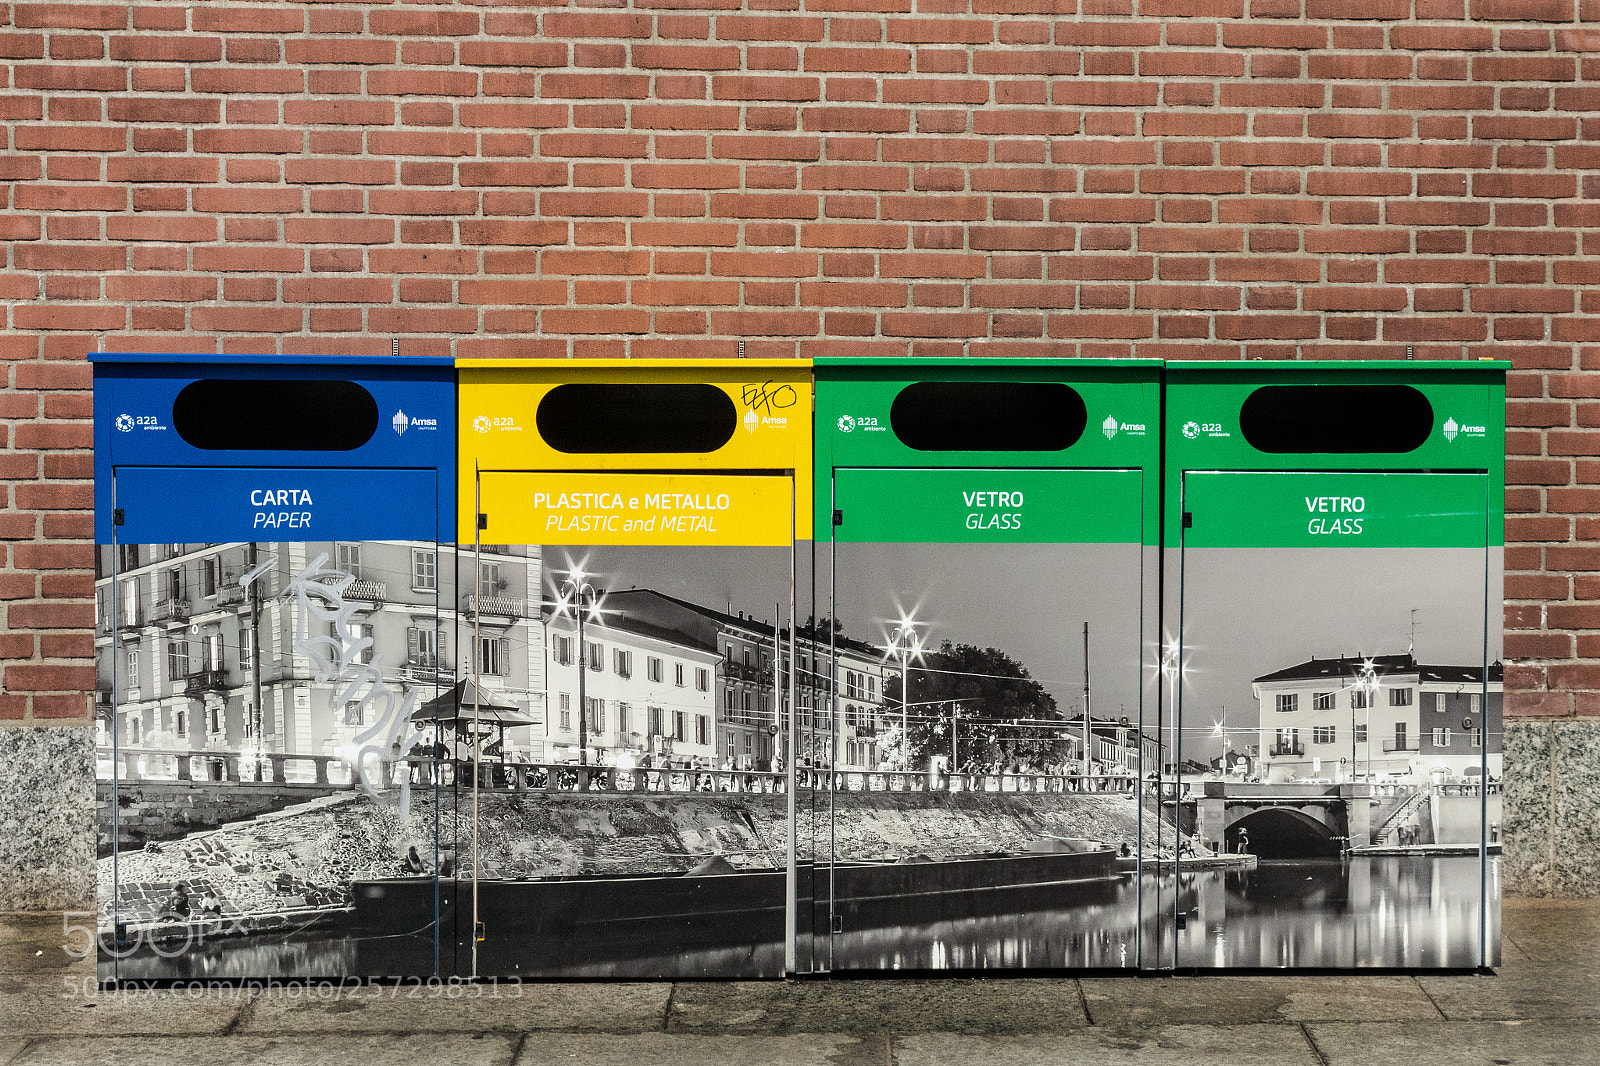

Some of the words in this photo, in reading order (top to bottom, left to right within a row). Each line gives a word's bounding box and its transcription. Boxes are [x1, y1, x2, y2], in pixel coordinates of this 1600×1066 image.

[136, 416, 158, 425] a2a
[411, 417, 437, 426] Amsa
[492, 417, 514, 426] a2a
[761, 416, 787, 425] Amsa
[857, 416, 878, 426] a2a
[1119, 422, 1146, 431] Amsa
[1201, 423, 1222, 432] a2a
[1460, 424, 1486, 433] Amsa
[250, 489, 313, 507] CARTA
[534, 492, 625, 510] PLASTICA
[628, 497, 639, 510] e
[644, 493, 730, 510] METALLO
[962, 491, 1024, 508] VETRO
[1304, 496, 1366, 513] VETRO
[253, 511, 312, 529] PAPER
[545, 515, 620, 532] PLASTIC
[622, 515, 657, 532] and
[660, 515, 718, 532] METAL
[965, 513, 1022, 530] GLASS
[1308, 518, 1364, 535] GLASS
